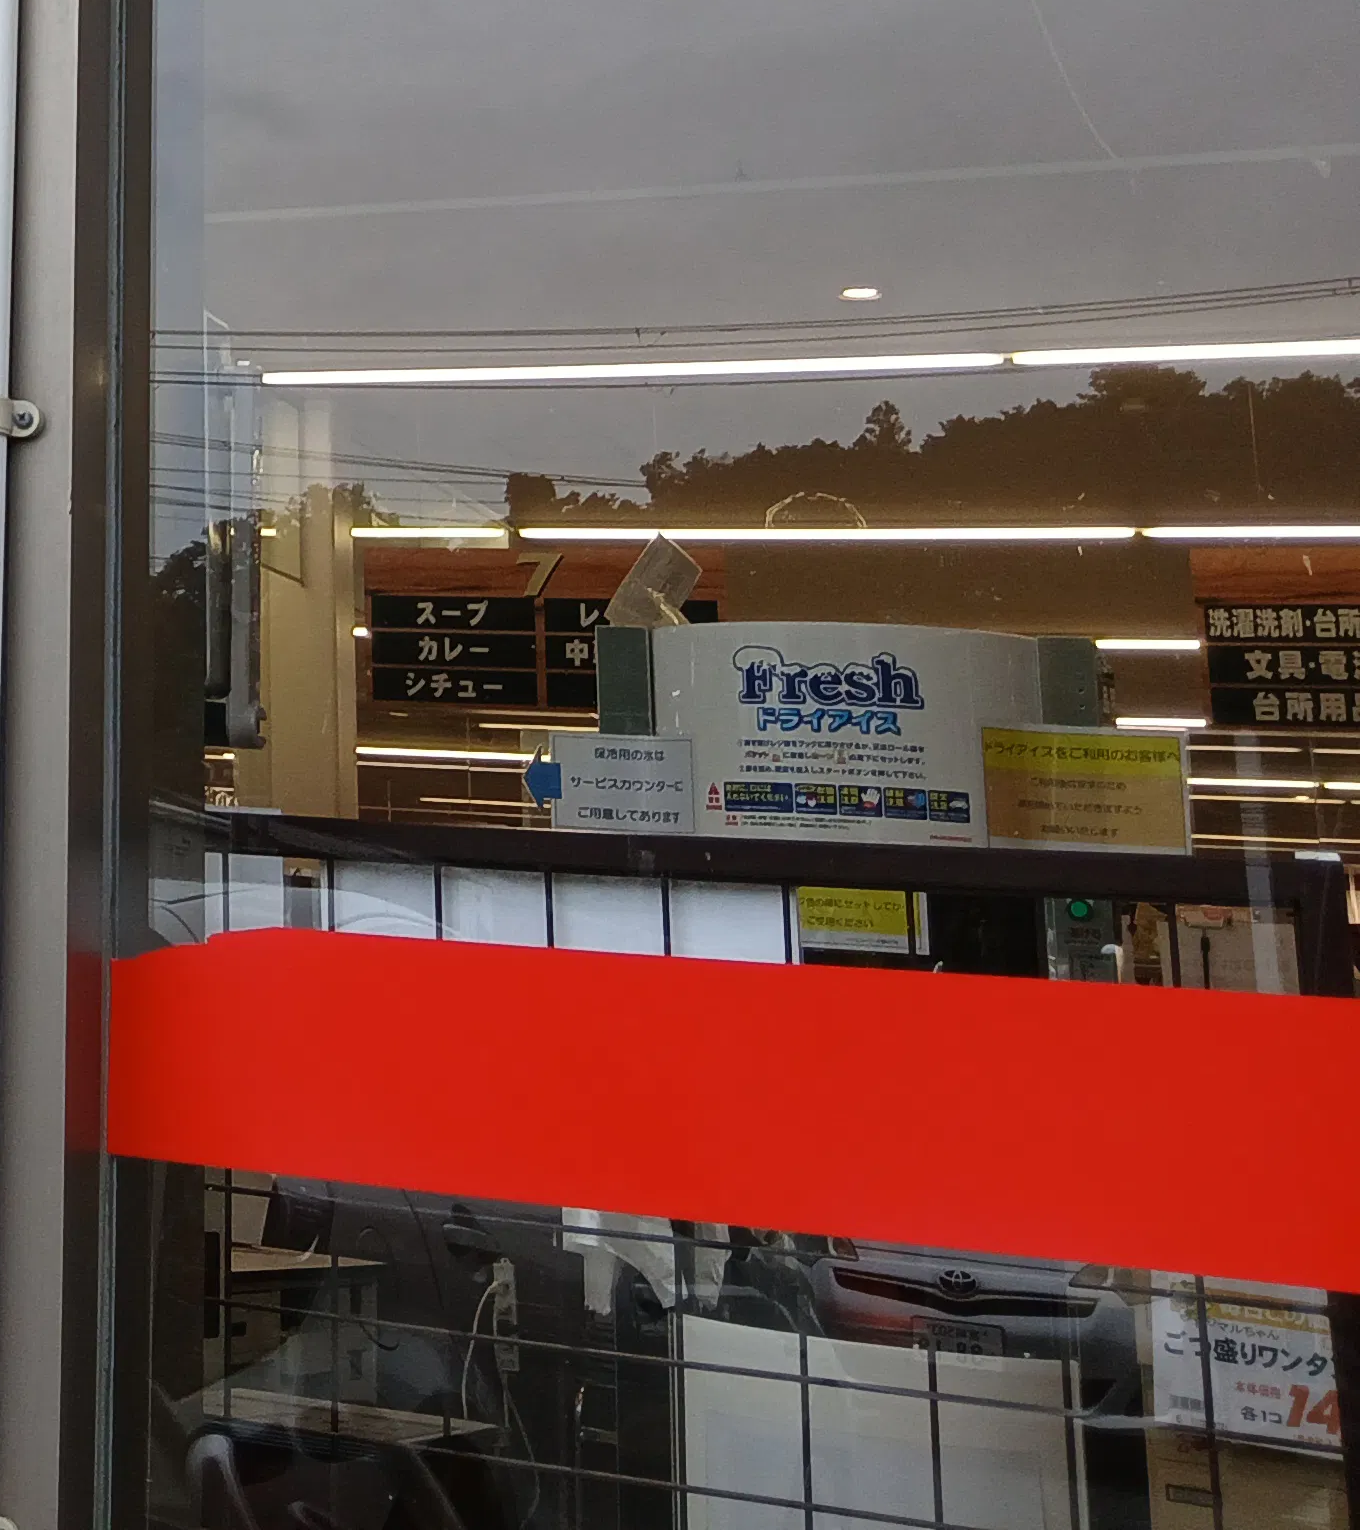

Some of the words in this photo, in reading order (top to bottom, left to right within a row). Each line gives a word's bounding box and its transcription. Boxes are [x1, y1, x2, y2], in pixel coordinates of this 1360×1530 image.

[514, 552, 564, 599] 7
[415, 599, 489, 627] スープ
[417, 634, 490, 662] カレー
[565, 638, 596, 667] 中
[404, 671, 504, 699] シチュー
[735, 647, 924, 711] Fresh
[755, 705, 902, 736] ドライアイス
[570, 775, 684, 792] サービスカウンターに
[578, 806, 680, 824] ご用意してあります
[1164, 1330, 1336, 1379] ごっ盛りワンタ
